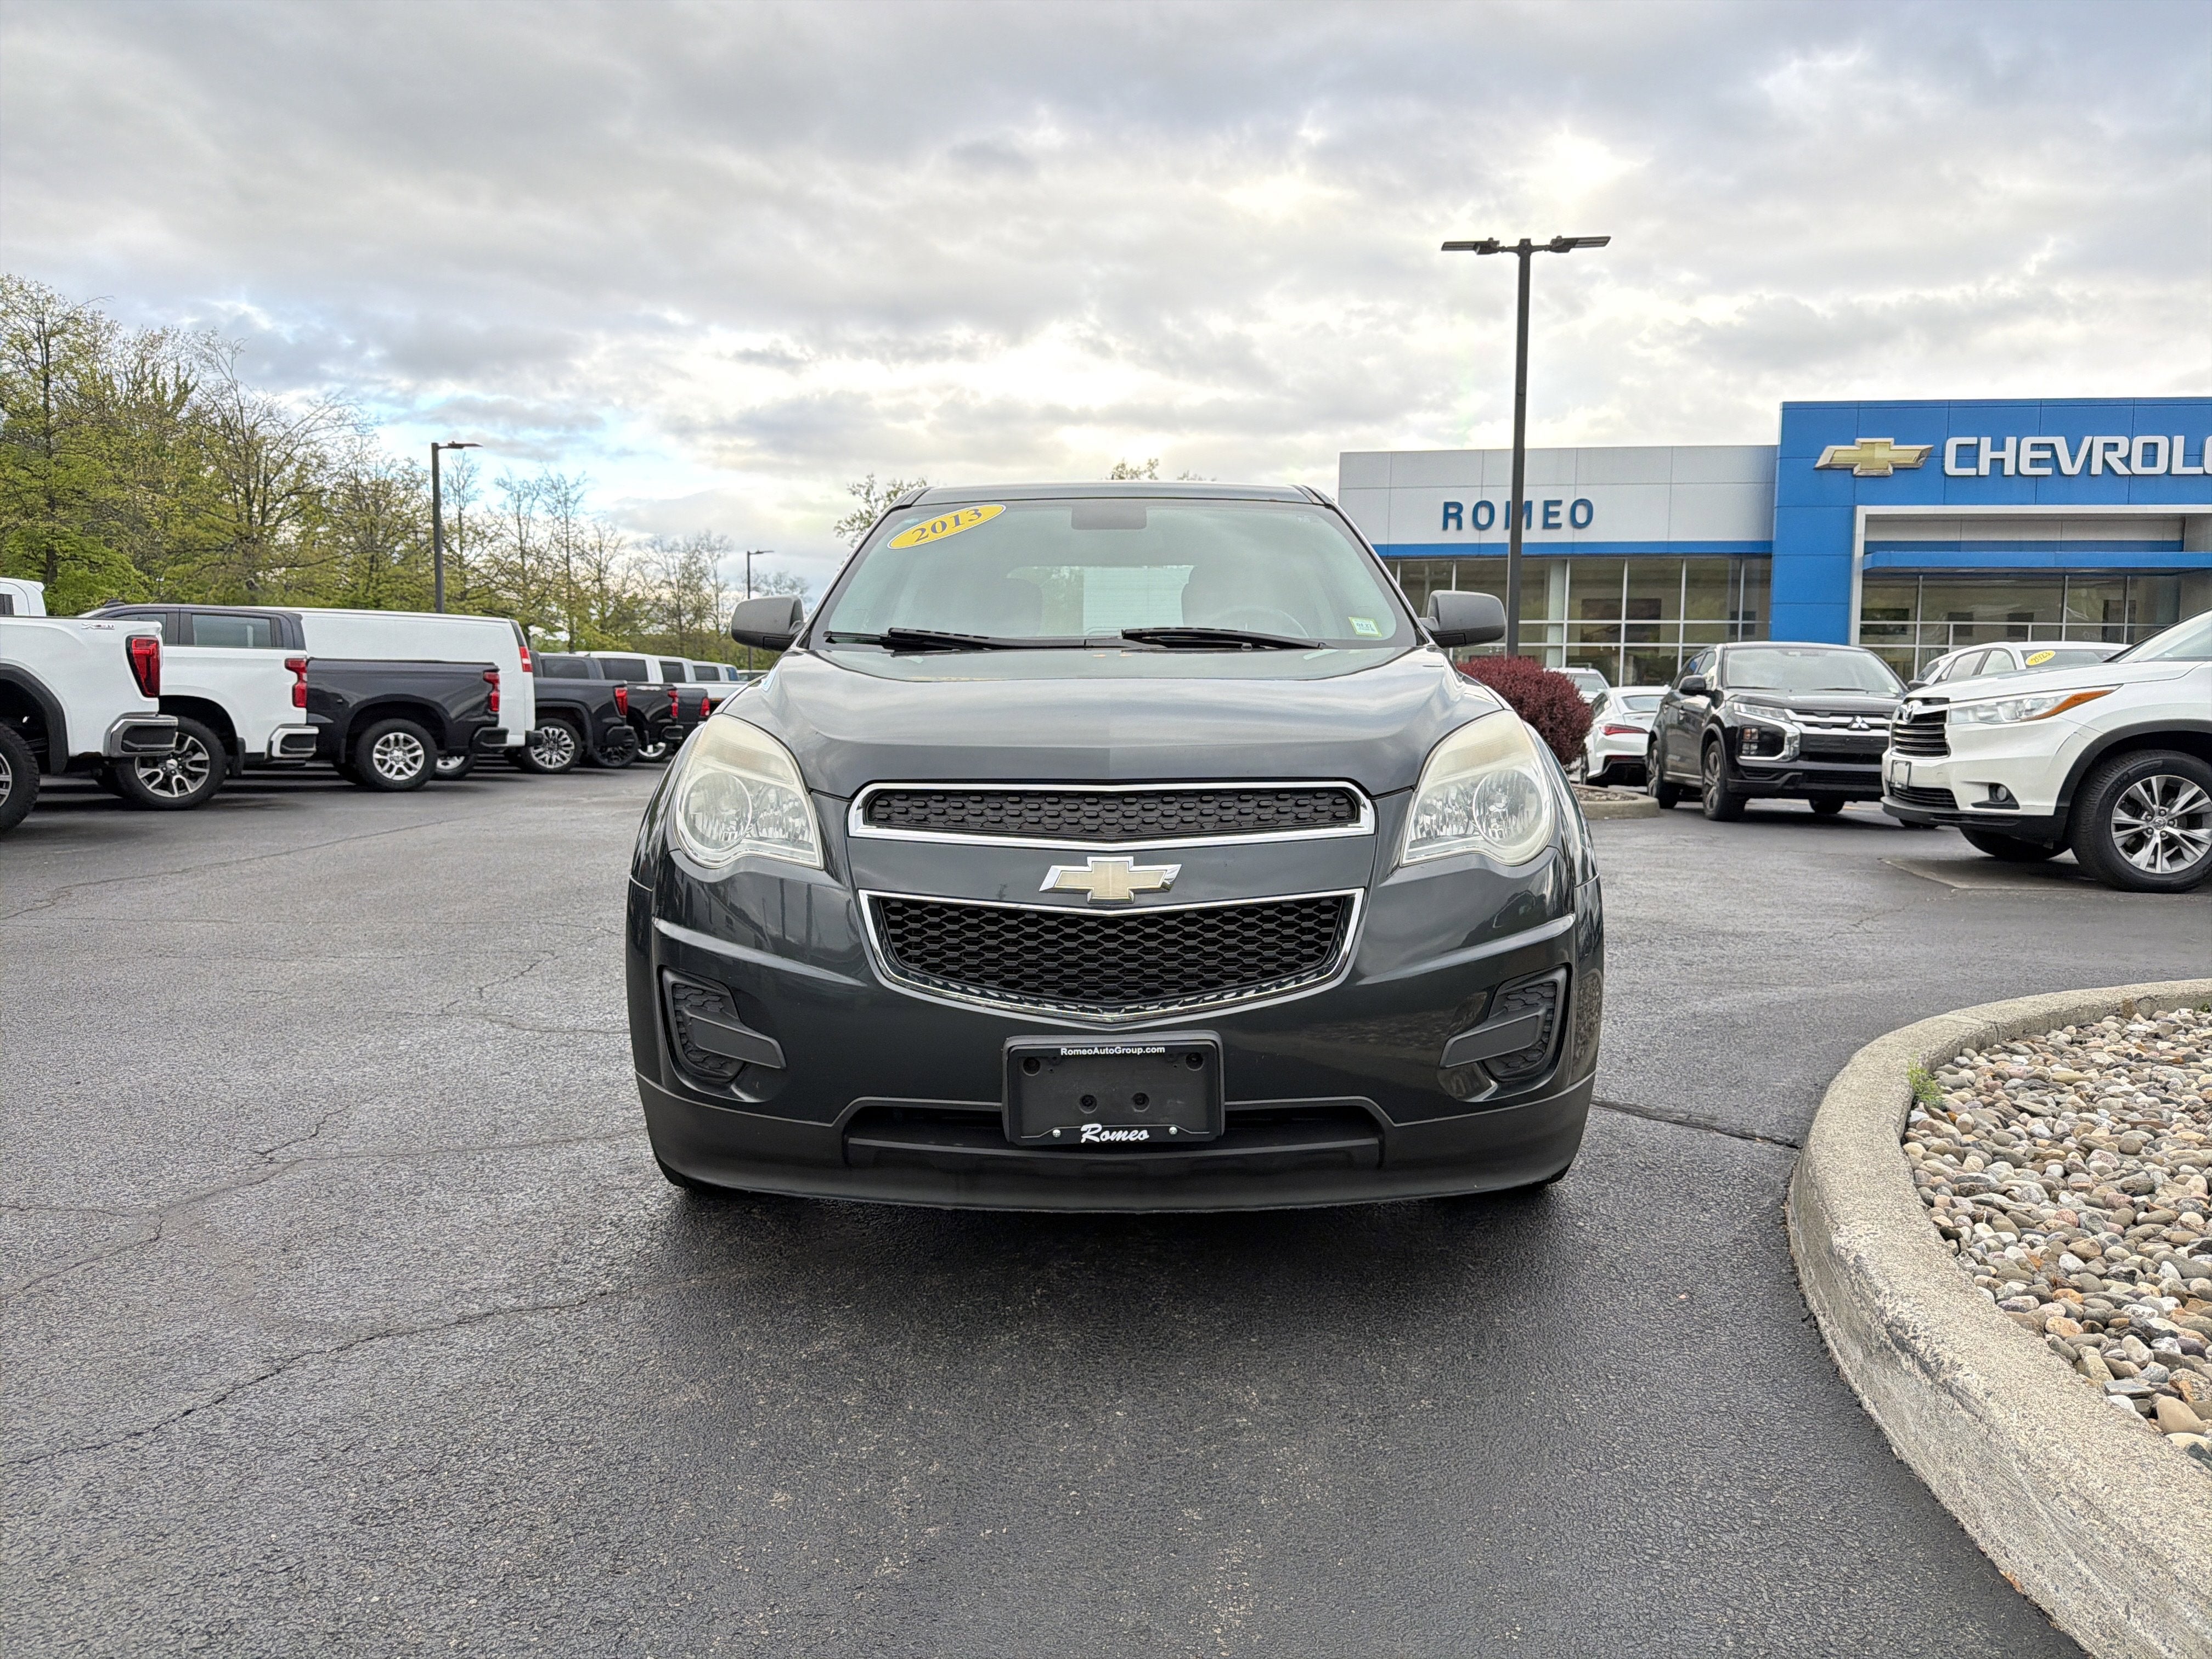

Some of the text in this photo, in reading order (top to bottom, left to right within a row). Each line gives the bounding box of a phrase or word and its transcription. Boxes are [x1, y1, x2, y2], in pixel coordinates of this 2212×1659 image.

[1944, 436, 2212, 476] CHEVROL
[912, 509, 982, 543] 2013
[1442, 498, 1594, 531] ROMEO
[1060, 1046, 1165, 1056] RomeoAutoGroup.com
[1080, 1123, 1150, 1143] Romeo
